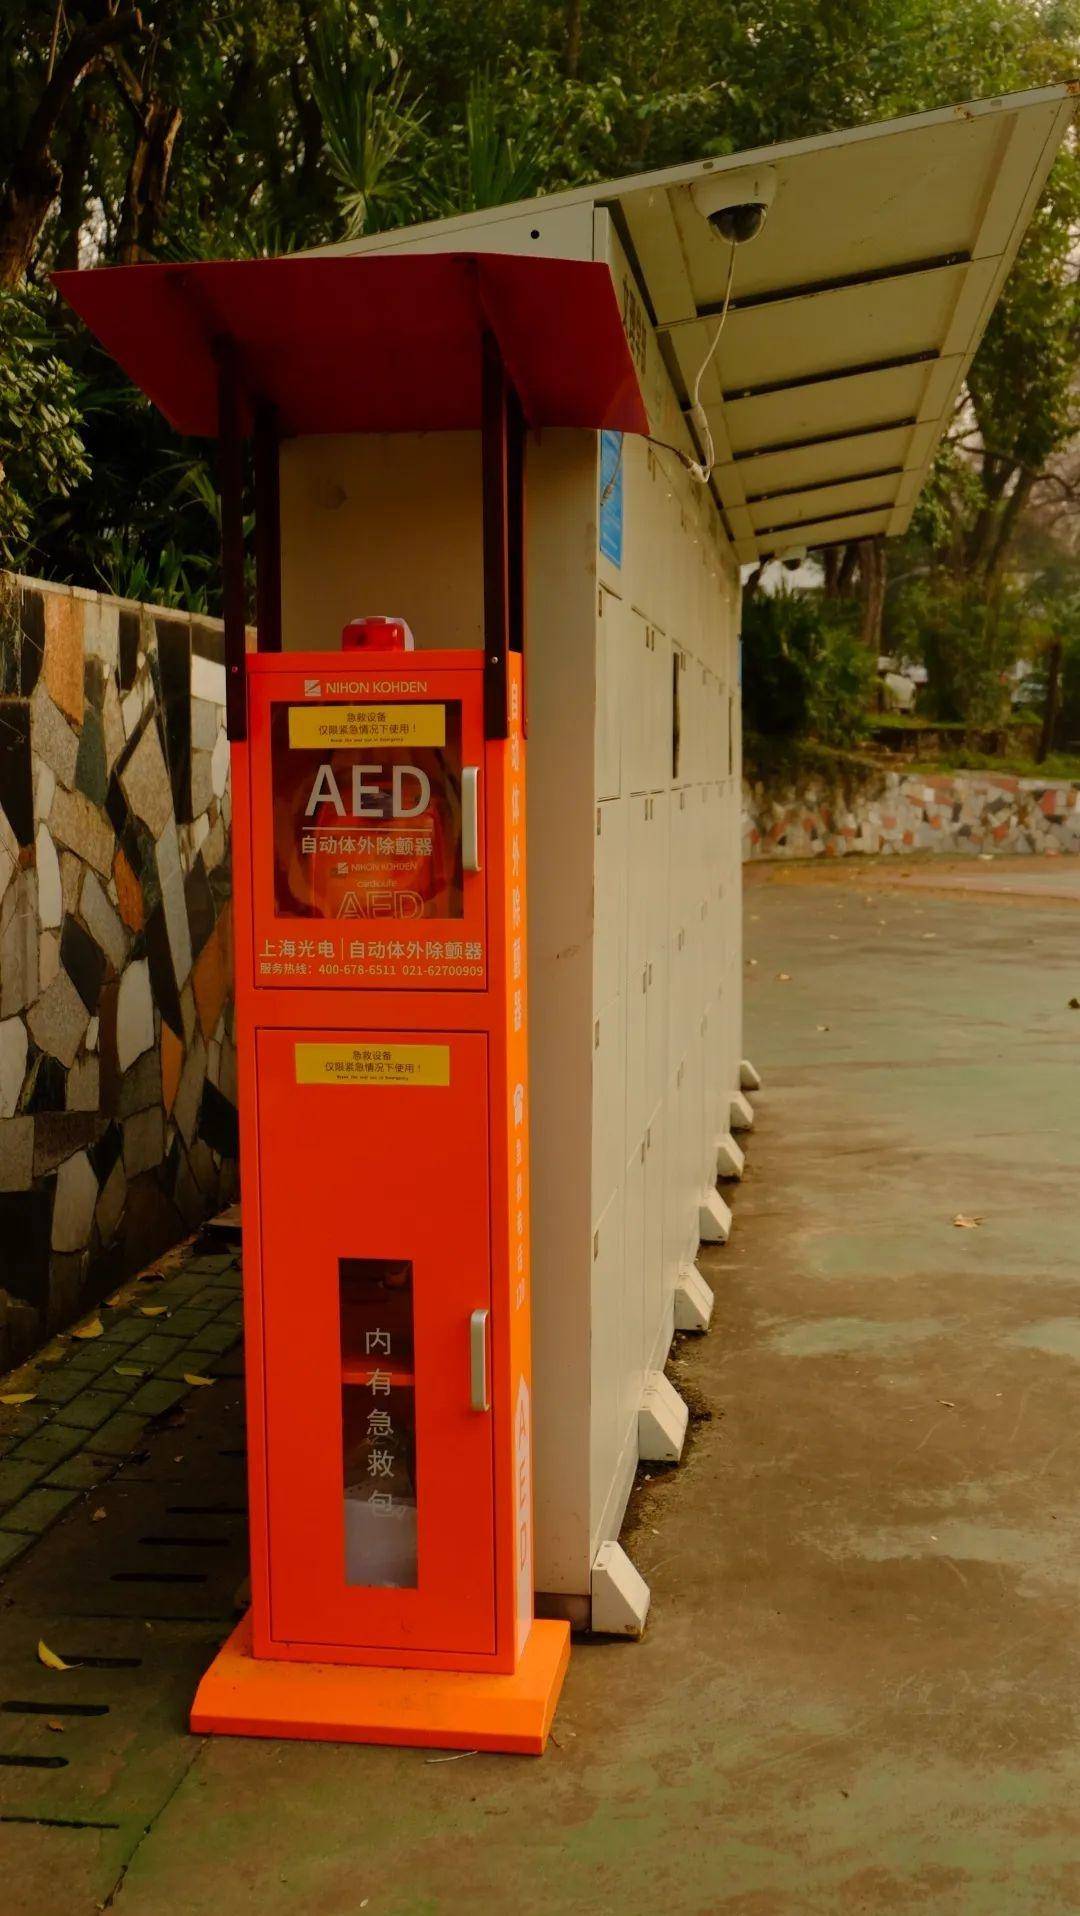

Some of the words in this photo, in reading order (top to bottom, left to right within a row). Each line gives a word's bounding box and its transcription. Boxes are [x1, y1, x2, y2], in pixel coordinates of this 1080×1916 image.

[326, 681, 369, 694] NIHON
[373, 681, 428, 693] KOHDEN
[346, 711, 387, 723] 急救设备
[304, 764, 431, 818] AED
[301, 835, 433, 856] 自动体外除颤器
[336, 890, 425, 919] AED
[259, 938, 335, 958] 上海光电
[350, 940, 483, 961] 自动体外除颤器
[318, 964, 396, 975] 400-678-6511
[402, 965, 484, 977] 021-62700909
[352, 1050, 392, 1061] 急救设备
[365, 1327, 395, 1518] 内有急救包
